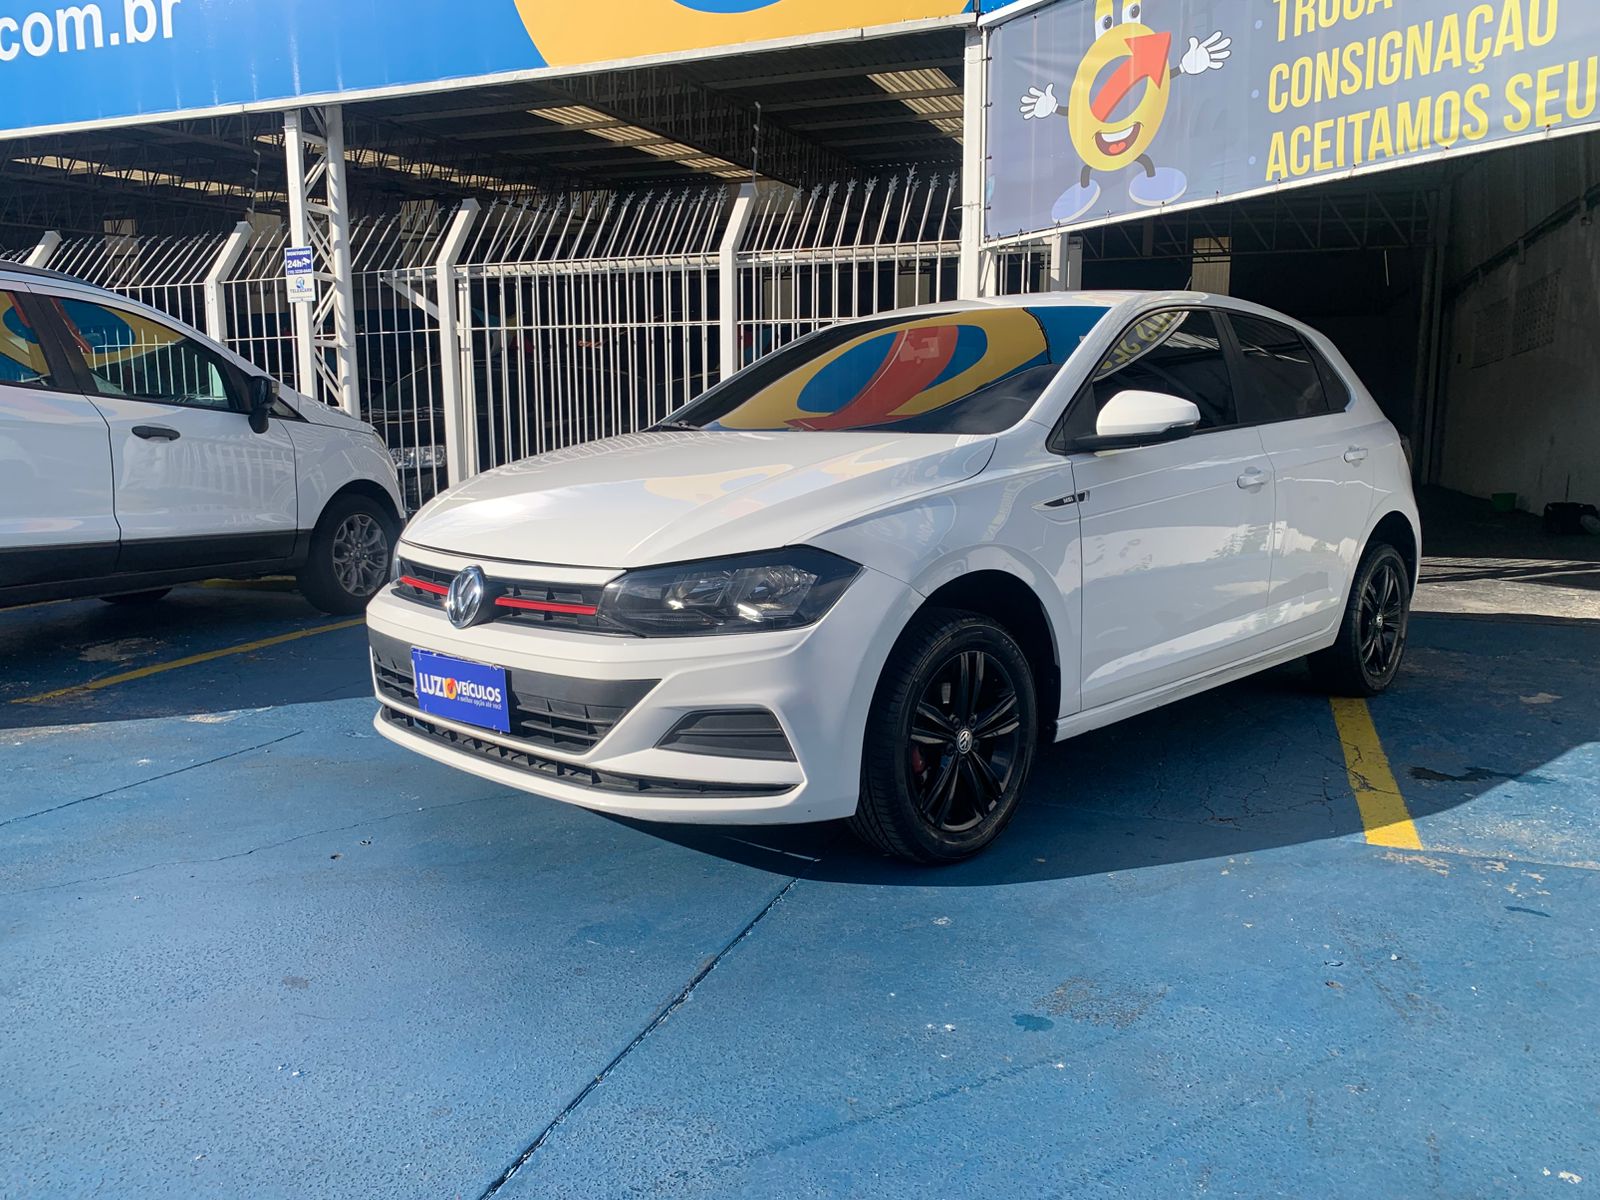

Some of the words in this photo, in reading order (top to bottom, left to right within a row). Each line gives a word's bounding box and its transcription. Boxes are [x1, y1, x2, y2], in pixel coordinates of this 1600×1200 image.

[0, 0, 181, 61] com.br
[1265, 83, 1491, 181] ACEITAMOS
[1503, 55, 1599, 132] SEU
[287, 259, 302, 268] 24h
[419, 672, 457, 700] LUZIO
[455, 680, 501, 703] VEÍCULOS
